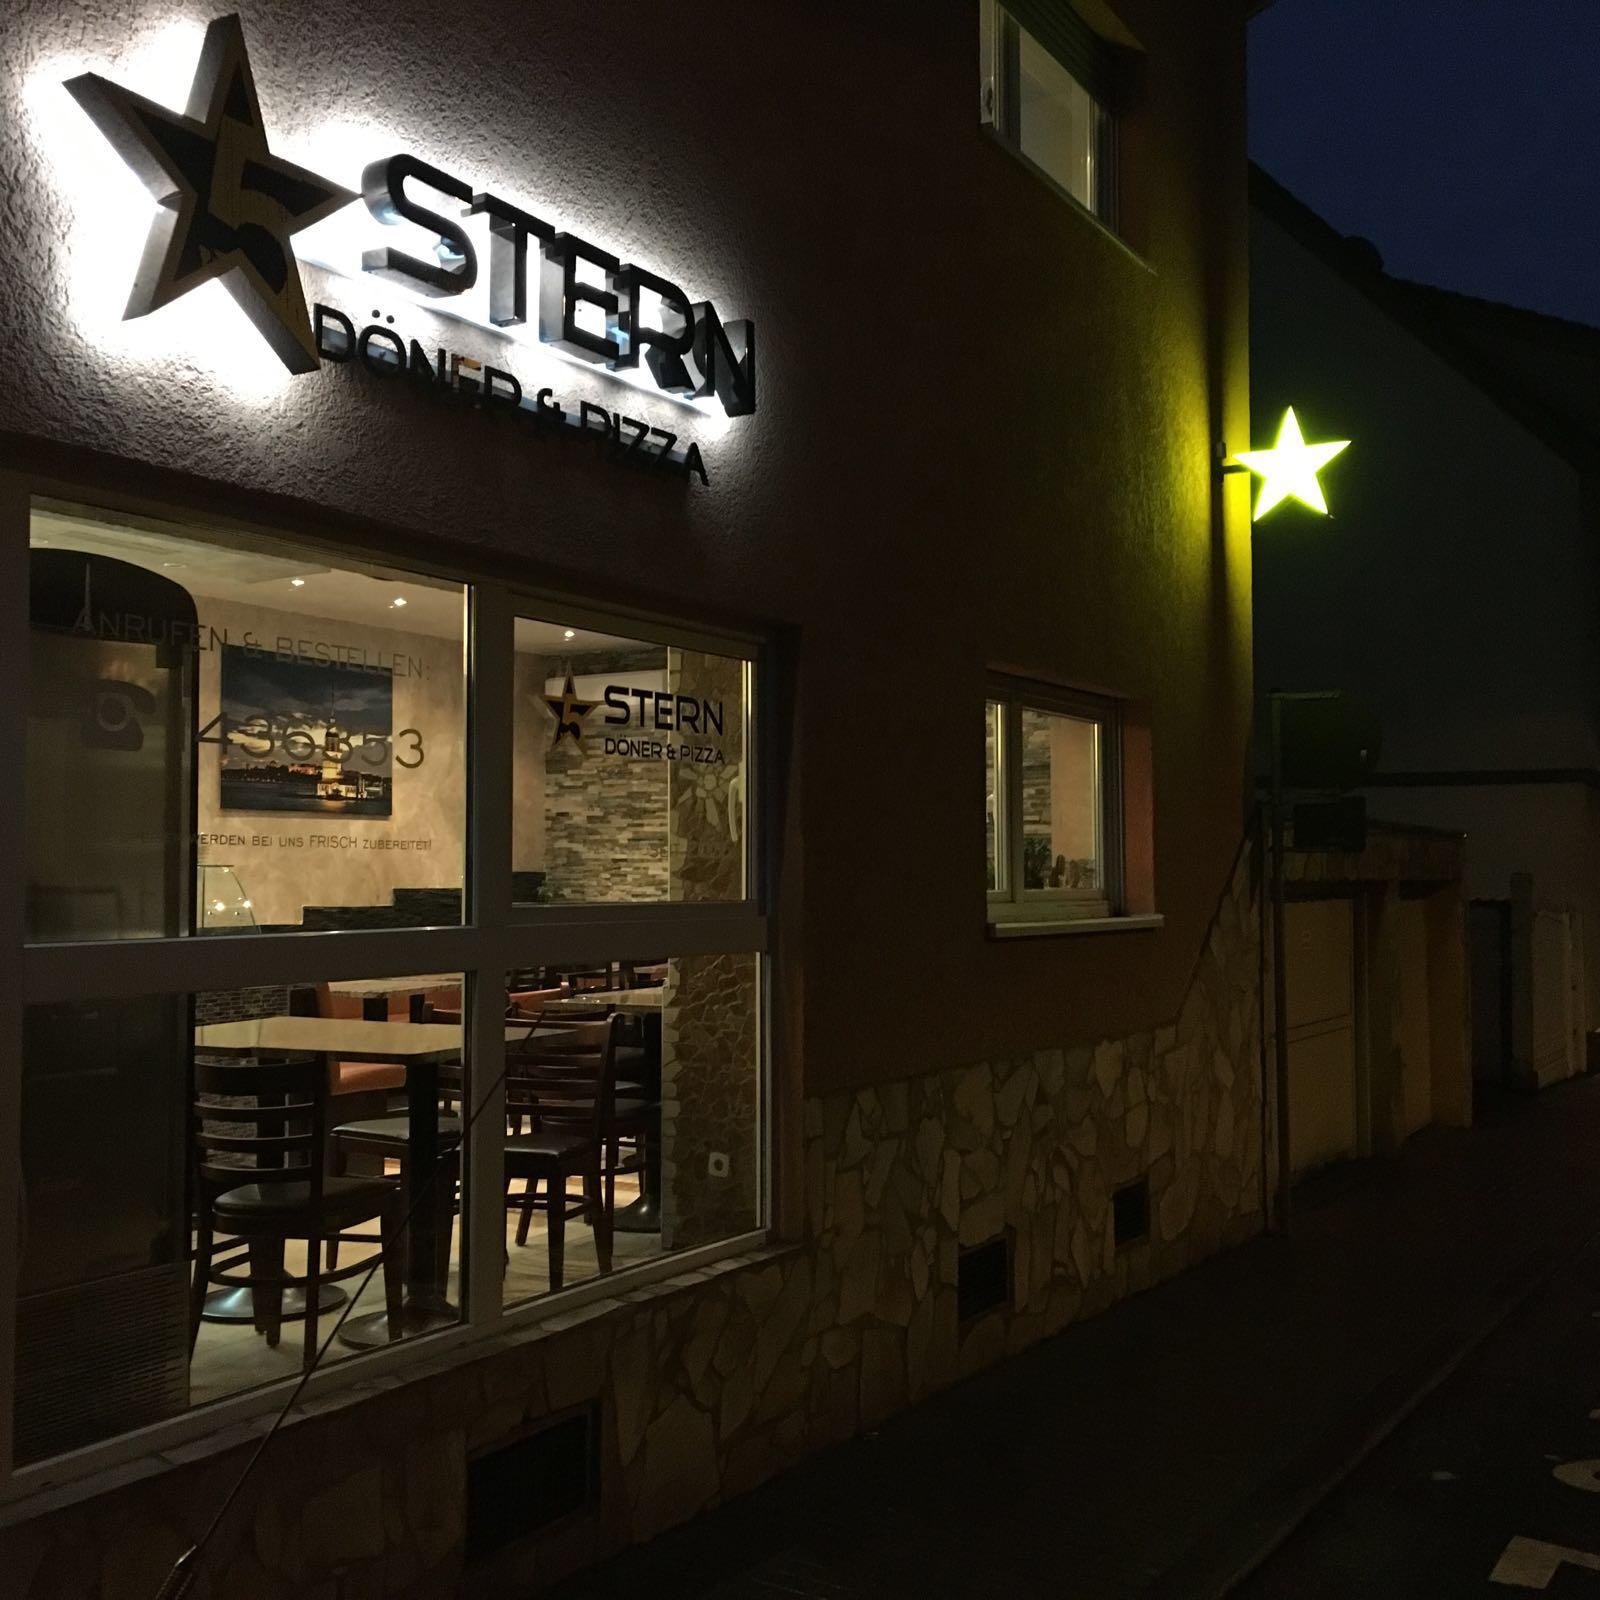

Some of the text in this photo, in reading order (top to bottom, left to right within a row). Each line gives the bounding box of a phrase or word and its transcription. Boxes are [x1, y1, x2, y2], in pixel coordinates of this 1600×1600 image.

[362, 153, 756, 417] STERN
[313, 302, 710, 487] DÖNER & PIZZA
[72, 606, 431, 681] ANRUFEN & BESTELLEN:
[603, 685, 724, 737] STERN
[604, 733, 726, 765] DÖNER & PIZZA
[251, 835, 273, 847] BEI
[278, 836, 304, 848] UNS
[309, 834, 358, 850] FRISCH
[362, 838, 433, 851] ZUBEREITET!
